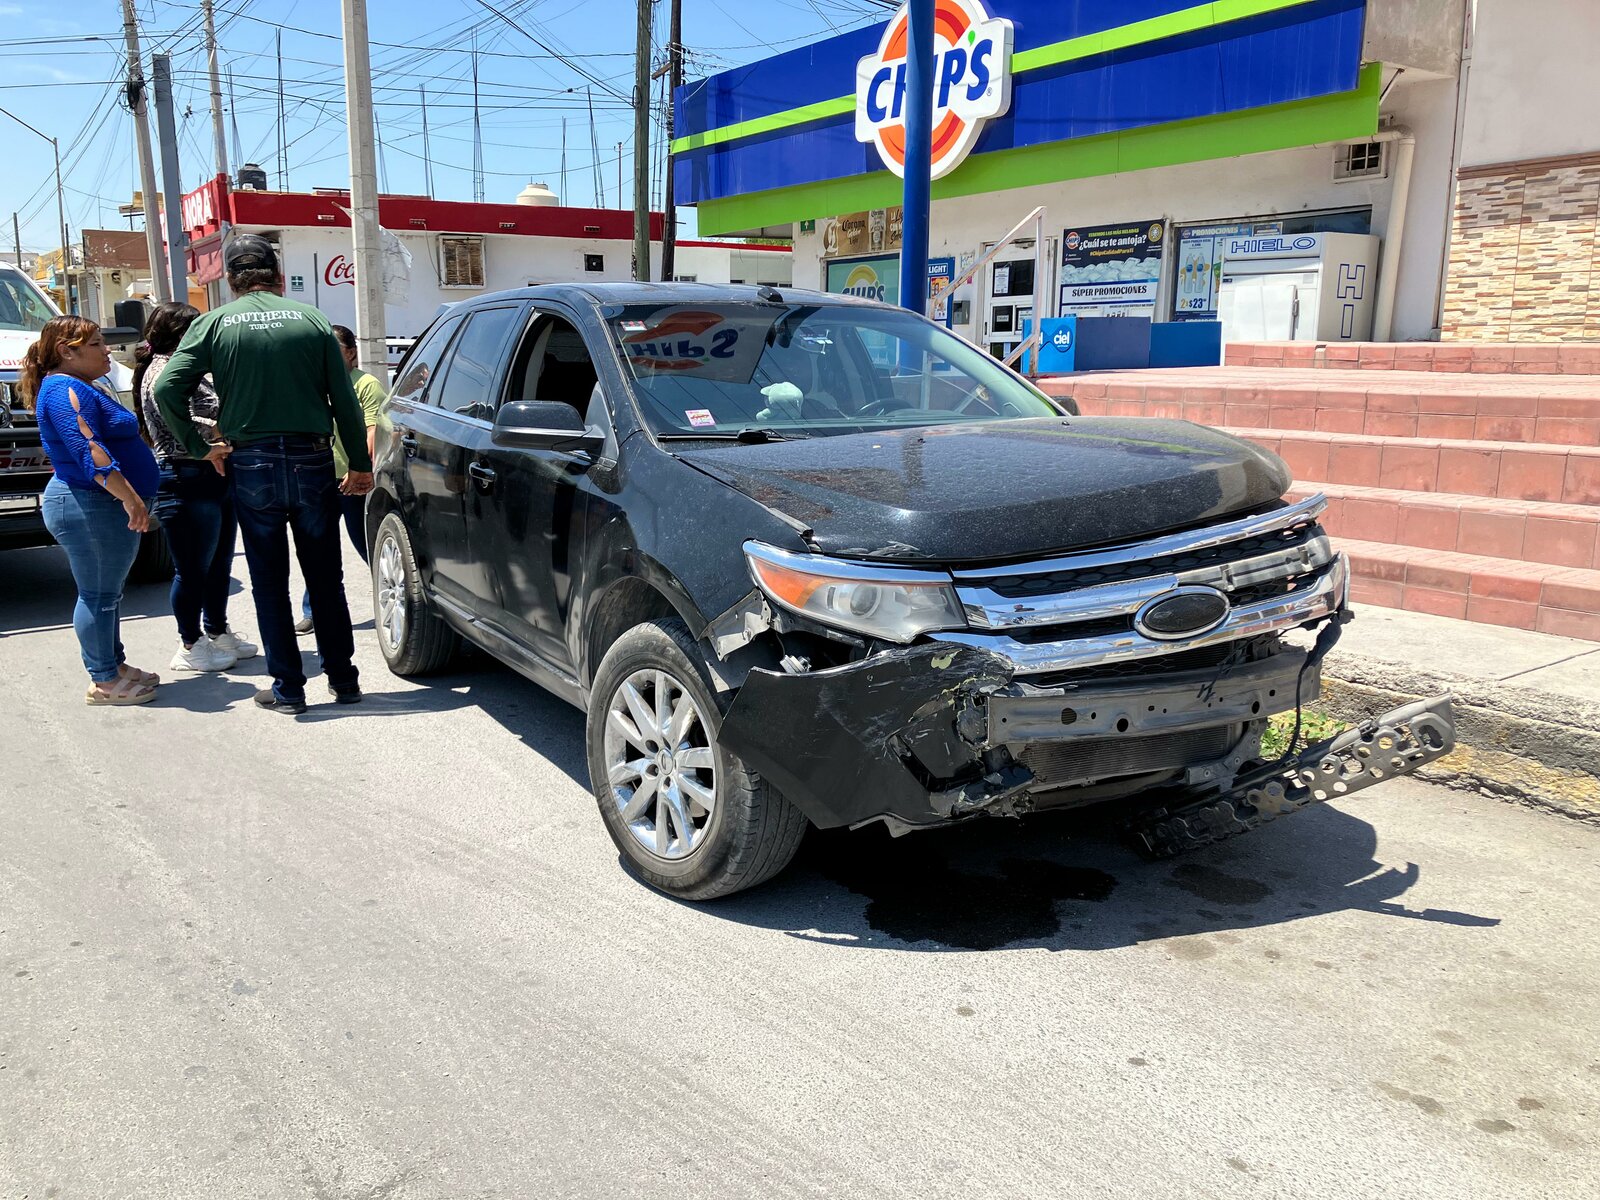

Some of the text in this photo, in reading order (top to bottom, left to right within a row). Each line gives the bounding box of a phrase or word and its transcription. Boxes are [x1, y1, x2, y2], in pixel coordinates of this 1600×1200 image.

[866, 38, 993, 123] CHP'S
[1079, 238, 1099, 250] ¿Cuál
[1117, 234, 1147, 246] antoja?
[1231, 236, 1316, 253] HIELO
[928, 265, 947, 273] LIGHT
[1094, 285, 1147, 296] PROMOCIONES
[223, 310, 302, 327] SOUTHERN
[1053, 330, 1070, 344] ciel
